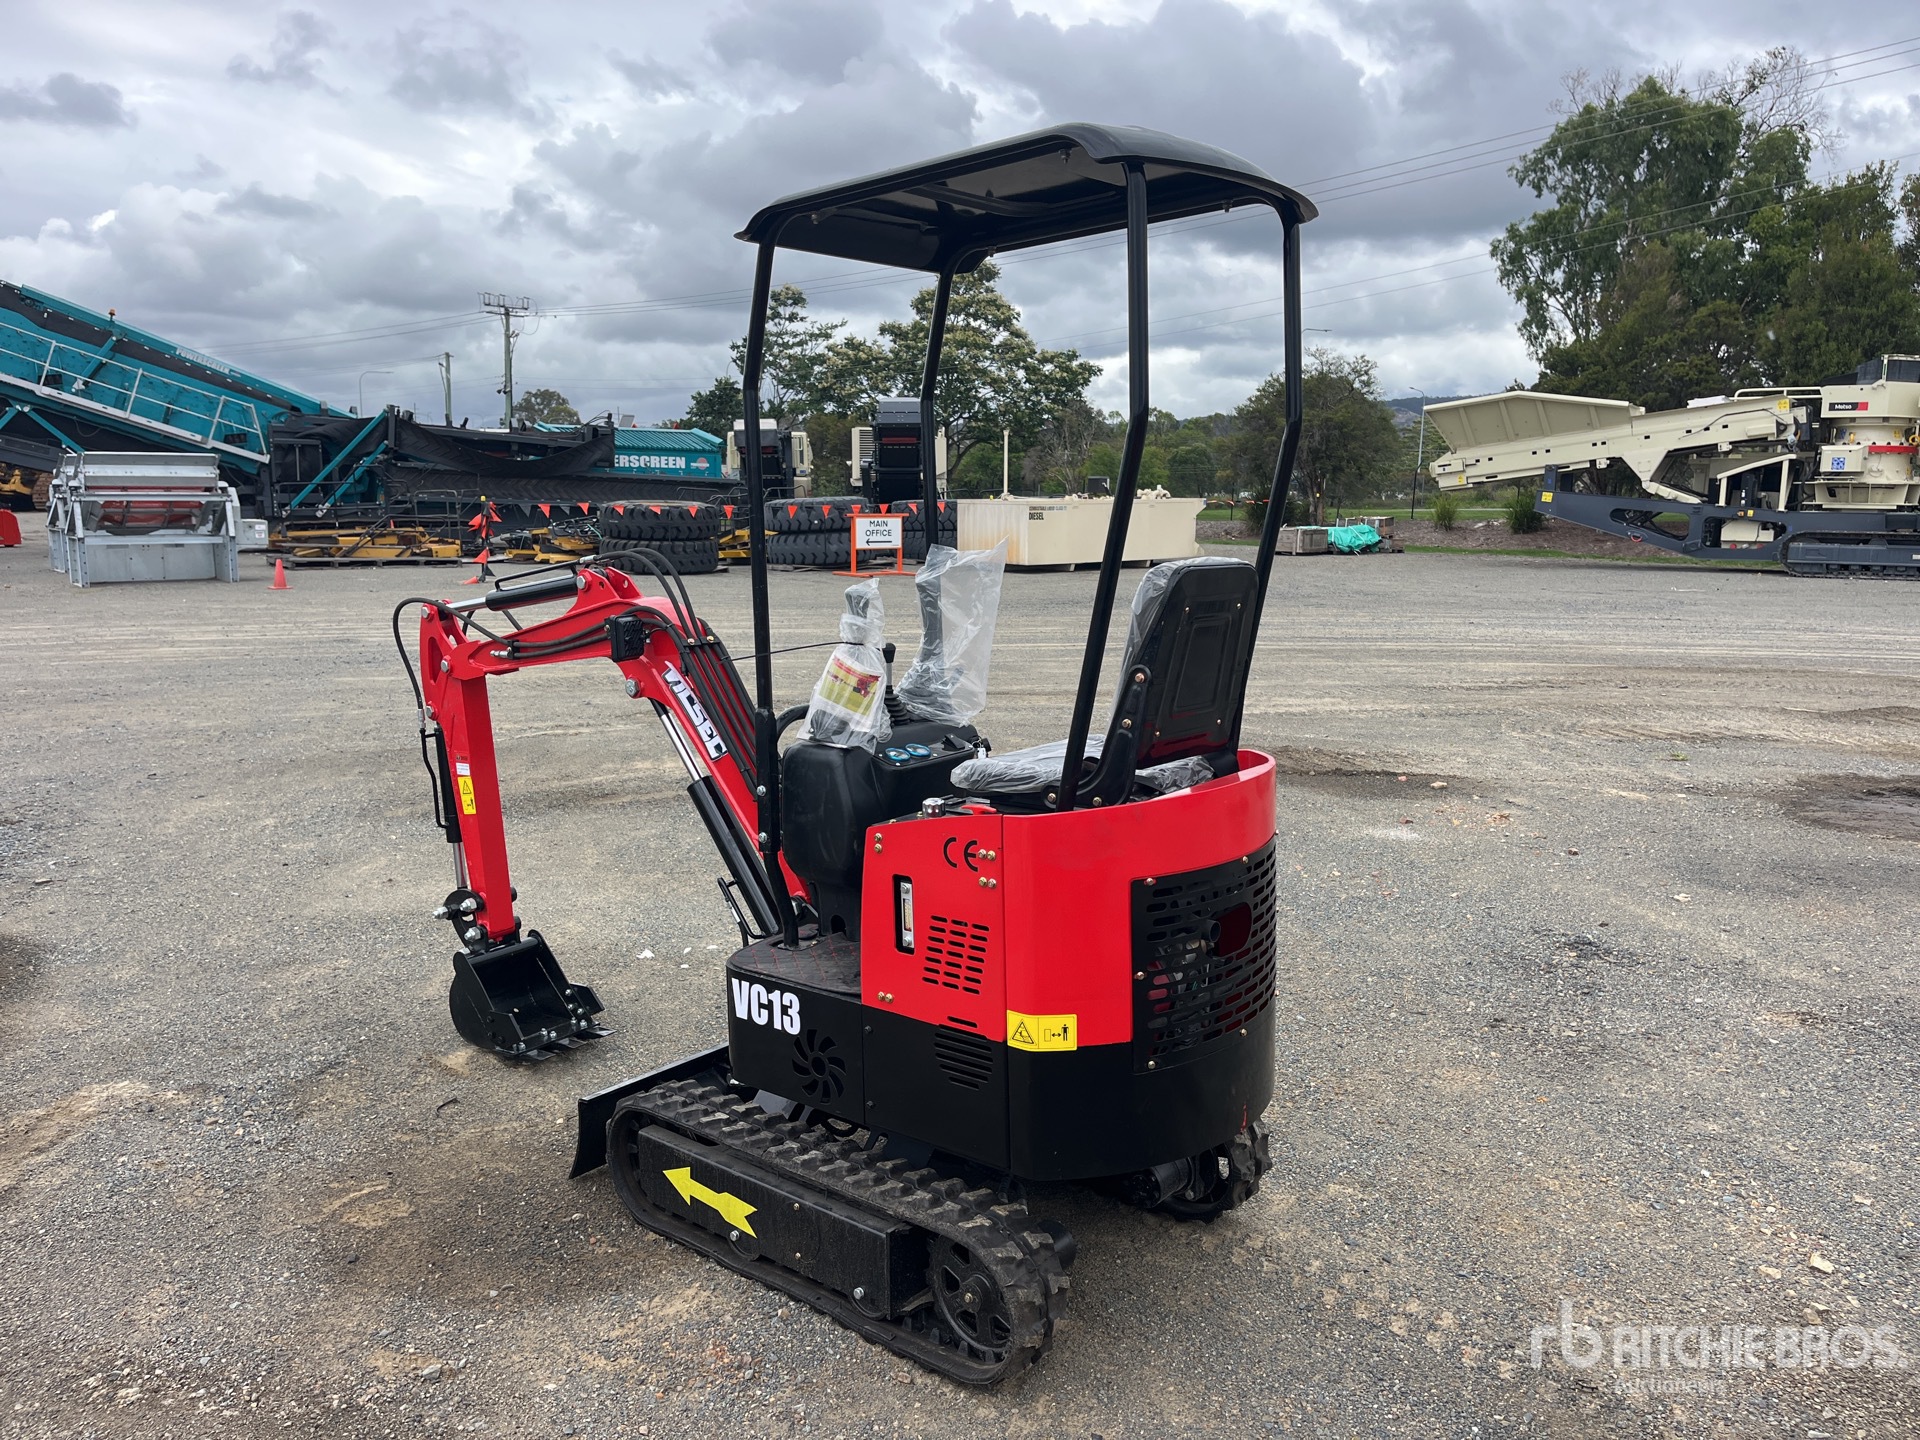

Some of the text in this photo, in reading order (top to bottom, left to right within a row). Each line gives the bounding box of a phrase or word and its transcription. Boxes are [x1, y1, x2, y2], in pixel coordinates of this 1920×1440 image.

[1028, 511, 1045, 521] DIESEL
[869, 520, 889, 528] MAIN
[865, 529, 893, 537] OFFICE
[731, 977, 801, 1036] VC13
